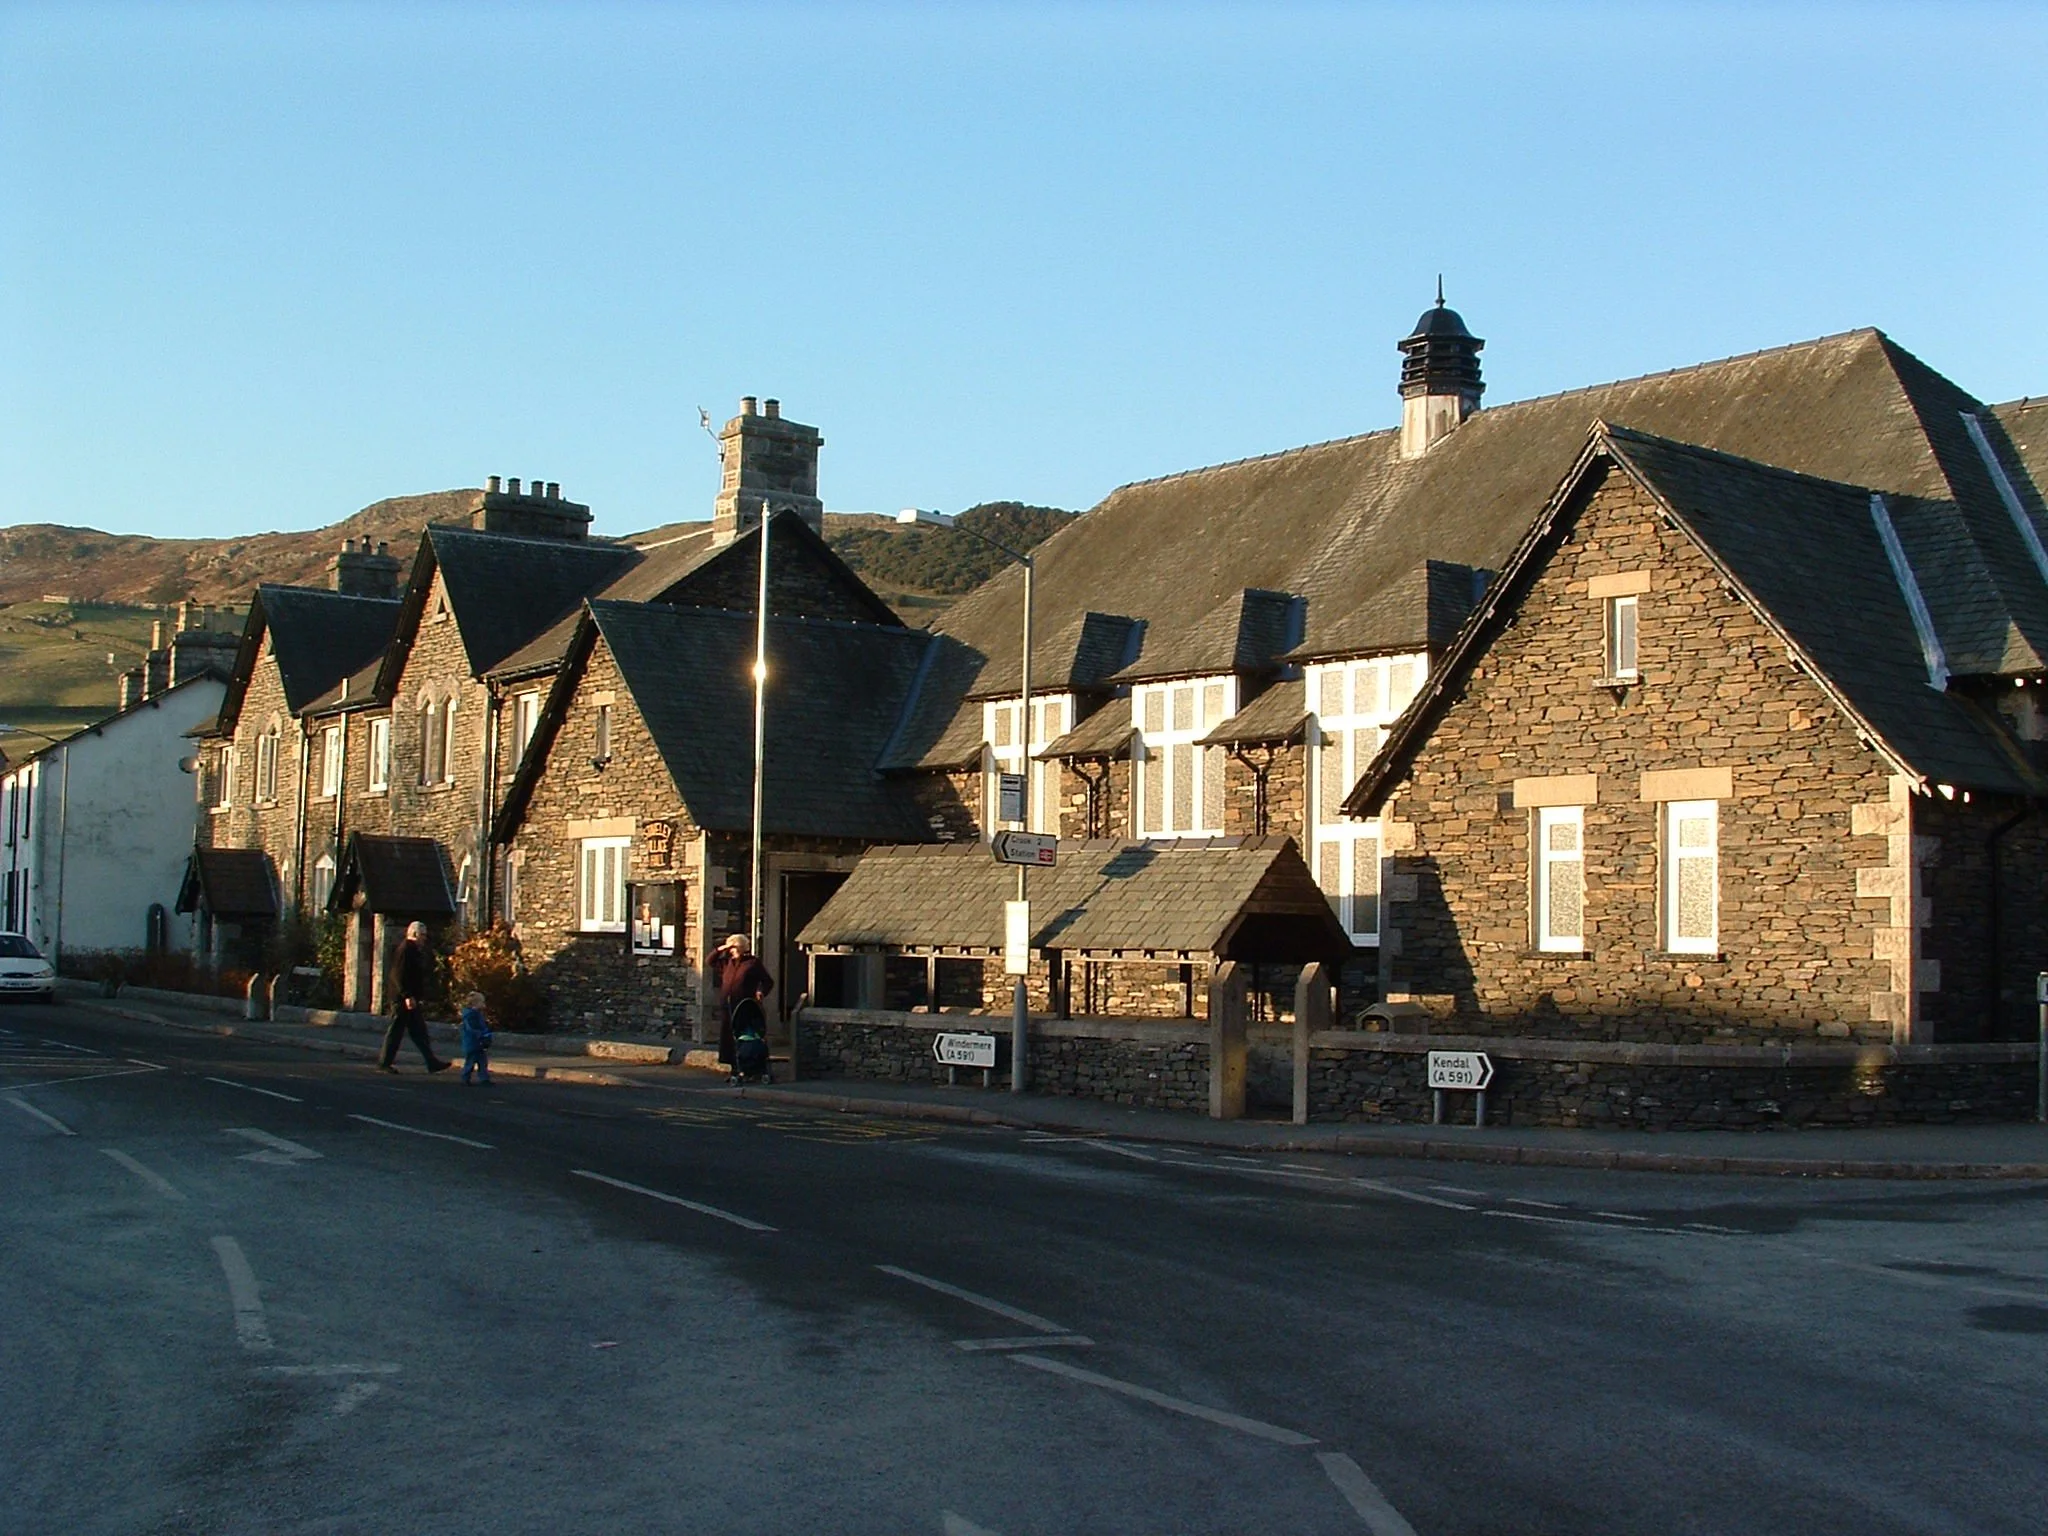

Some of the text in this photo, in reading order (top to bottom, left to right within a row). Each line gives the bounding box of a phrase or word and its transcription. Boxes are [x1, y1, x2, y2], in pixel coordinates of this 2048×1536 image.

[1010, 848, 1035, 857] Station
[947, 1039, 992, 1050] Windermere
[1433, 1056, 1470, 1068] Kendal
